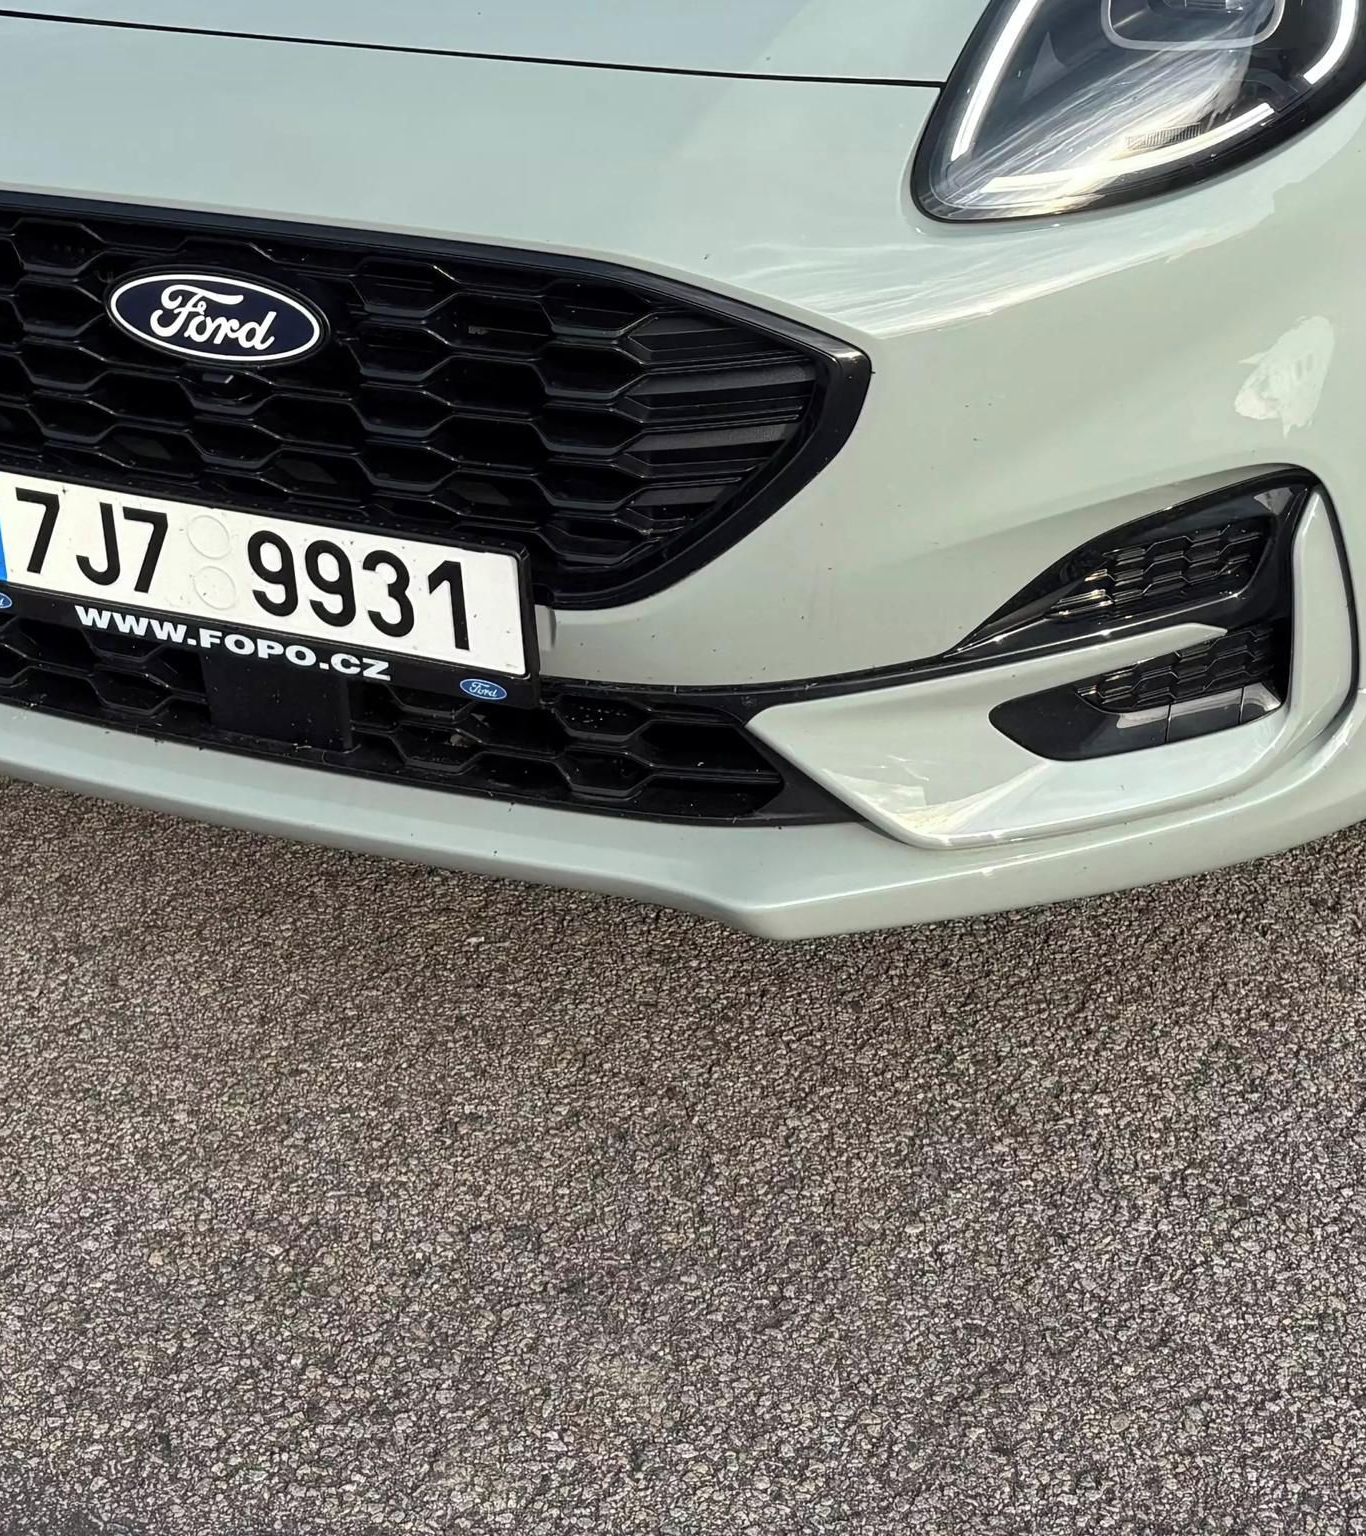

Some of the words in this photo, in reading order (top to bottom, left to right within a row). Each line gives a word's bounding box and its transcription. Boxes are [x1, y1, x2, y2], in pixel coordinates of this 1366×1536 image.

[149, 284, 275, 353] Ford
[14, 487, 168, 594] 7J7
[246, 529, 471, 652] 9931
[74, 604, 393, 682] WWW.FOPO.CZ
[469, 681, 498, 697] Ford
